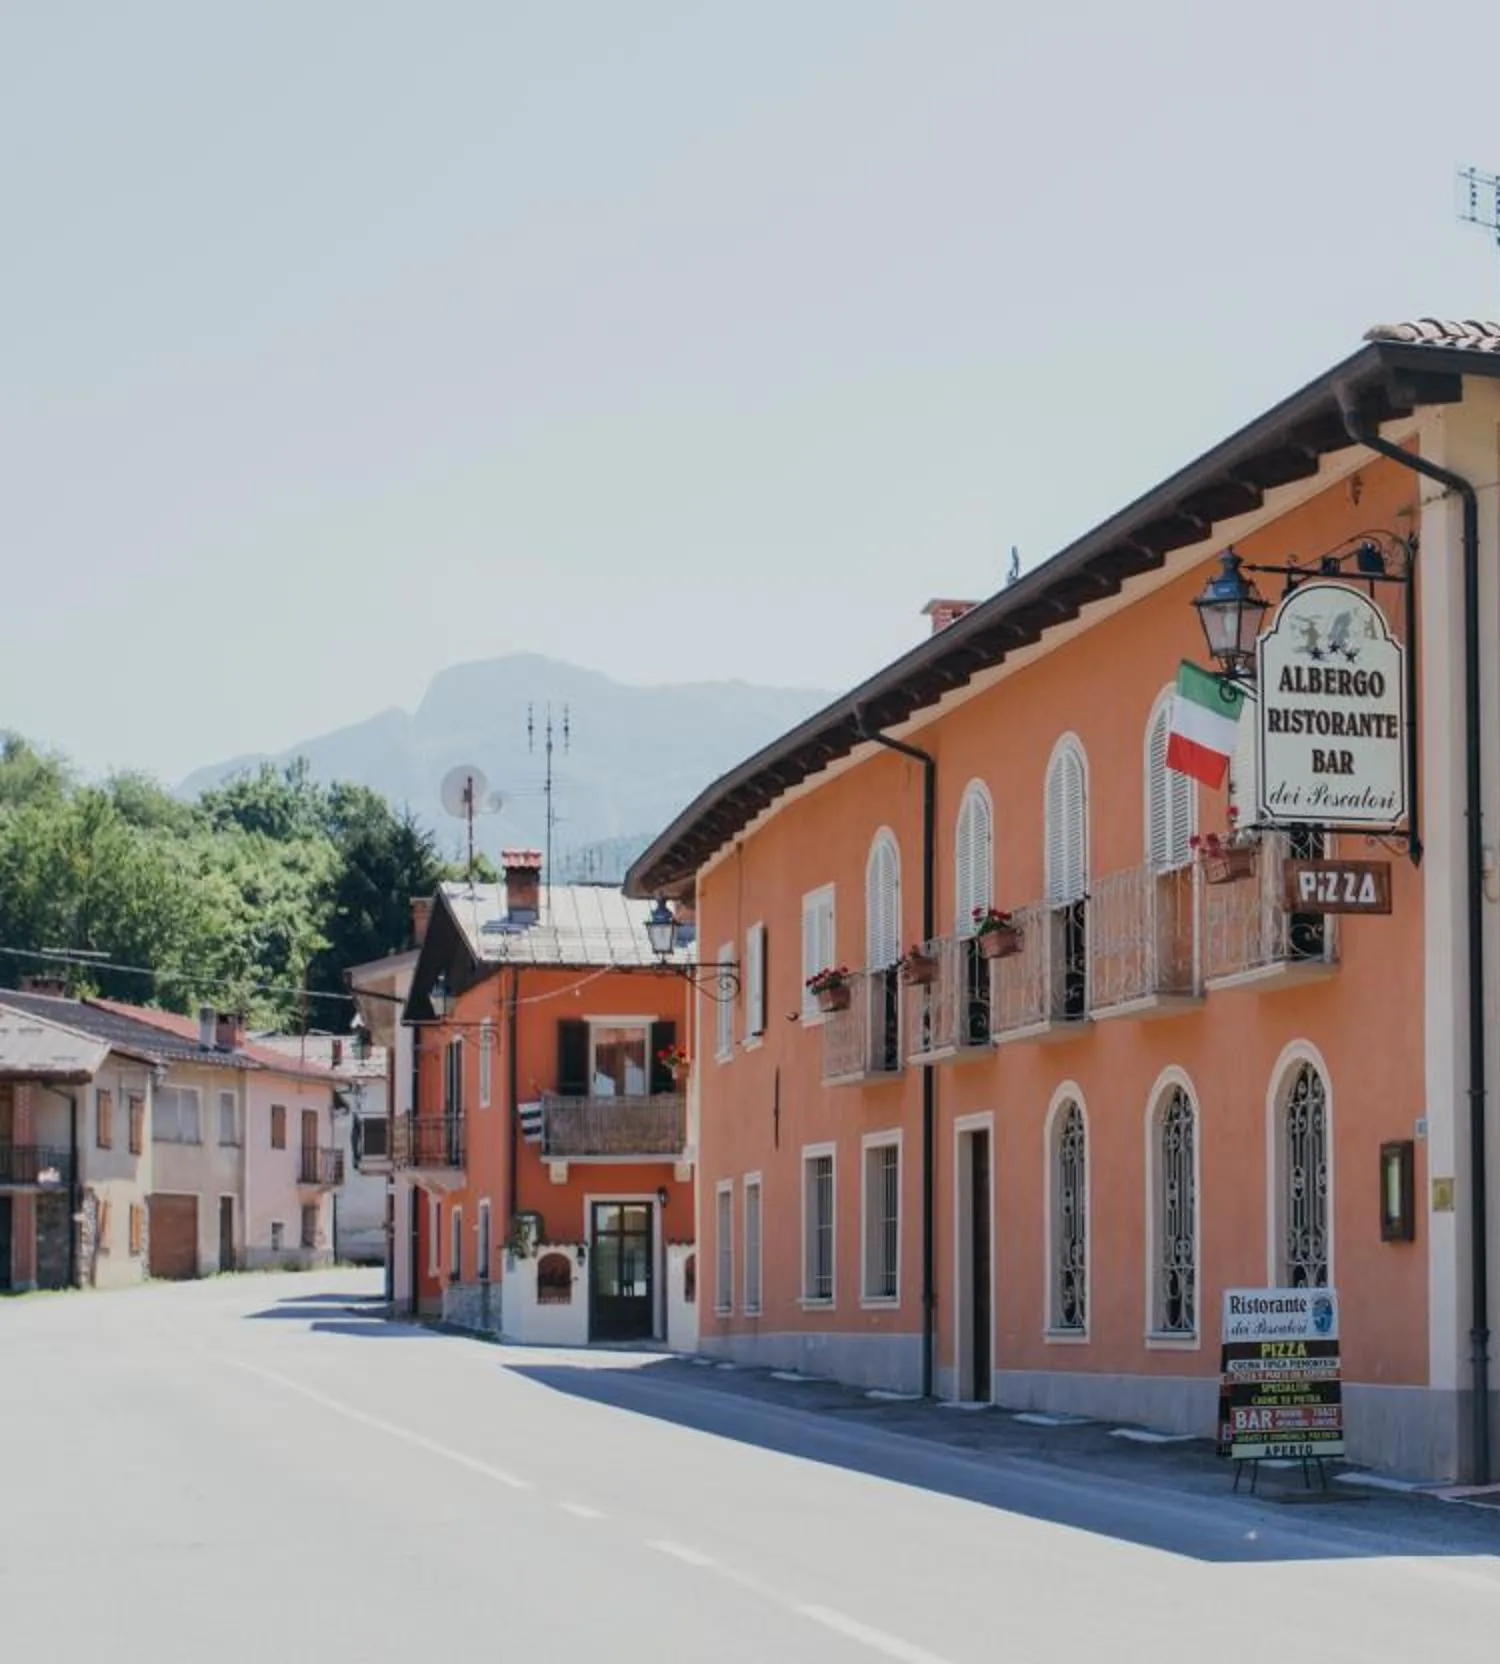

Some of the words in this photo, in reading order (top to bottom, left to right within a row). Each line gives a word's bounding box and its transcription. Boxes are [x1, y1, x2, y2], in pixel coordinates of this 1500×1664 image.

[1279, 665, 1386, 698] ALBERGO
[1267, 708, 1399, 740] RISTORANTE
[1311, 748, 1355, 776] BAR
[1269, 780, 1299, 806] dei
[1306, 781, 1397, 812] Pescatori
[1229, 1295, 1308, 1315] Ristorante
[1260, 1342, 1308, 1358] PIZZA
[1235, 1410, 1273, 1430] BAR
[1264, 1443, 1314, 1457] APERTO
